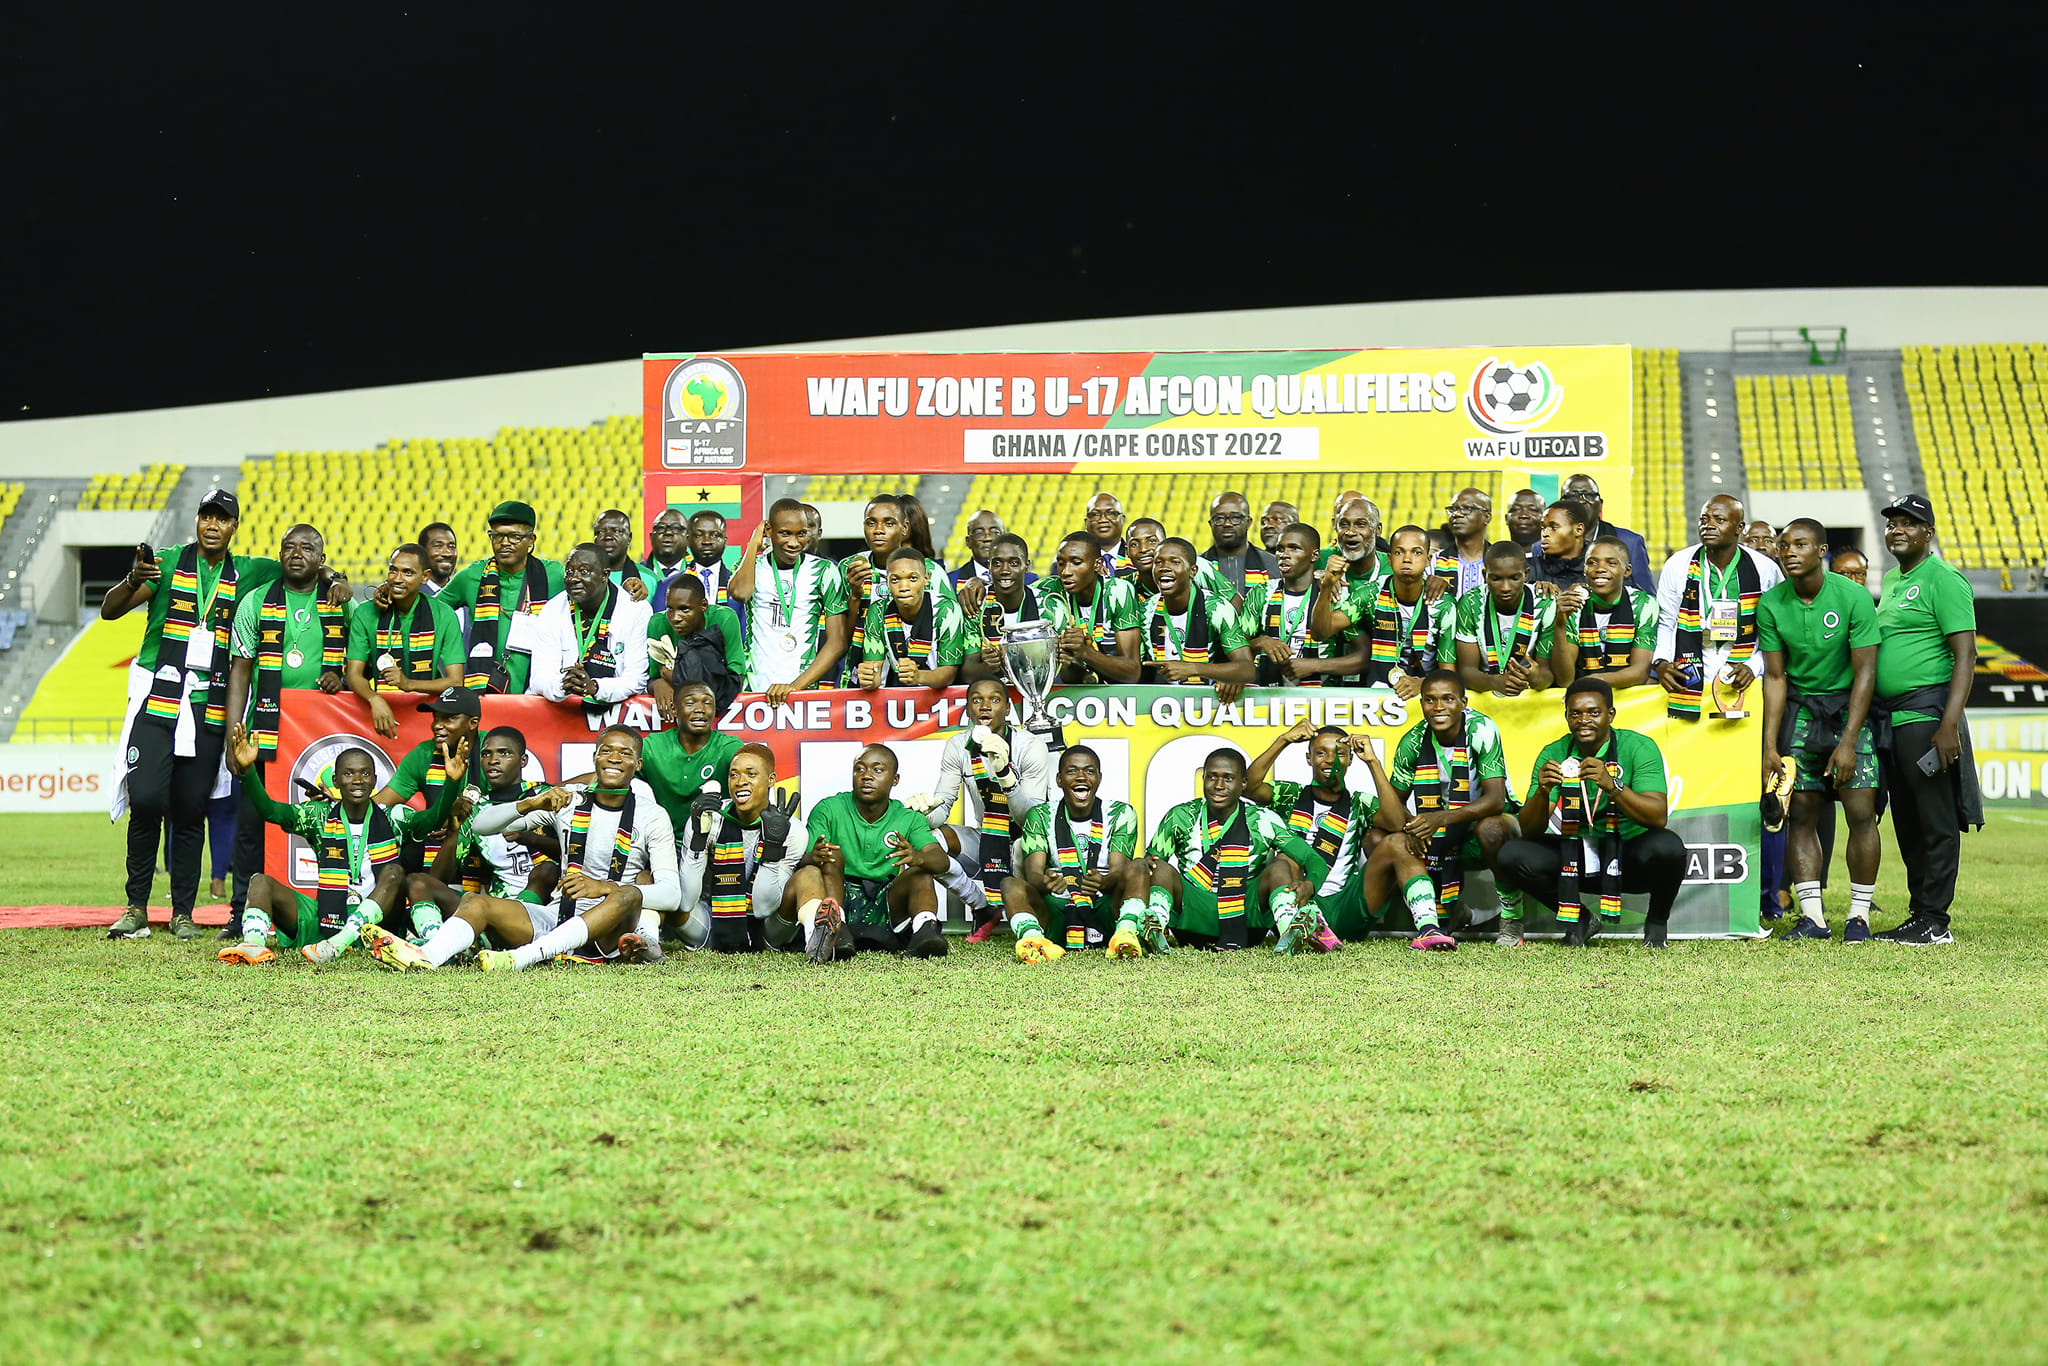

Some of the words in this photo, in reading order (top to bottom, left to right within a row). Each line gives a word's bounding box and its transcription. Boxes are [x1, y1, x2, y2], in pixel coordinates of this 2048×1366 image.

[806, 376, 910, 417] WAFU
[915, 376, 1004, 417] ZONE
[1010, 376, 1037, 417] B
[1043, 375, 1119, 417] U-17
[1123, 374, 1243, 416] AFCON
[1251, 371, 1457, 418] QUALIFIERS
[680, 421, 728, 434] CAF
[992, 433, 1066, 458] GHANA
[1146, 432, 1219, 457] COAST
[1224, 431, 1282, 456] 2022
[1467, 441, 1521, 457] WAFU
[1528, 438, 1577, 456] UFOA
[1583, 435, 1605, 457] B
[583, 703, 679, 732] WAF
[717, 700, 832, 731] ZONE
[845, 699, 873, 730] B
[1150, 695, 1409, 729] QUALIFIERS
[506, 851, 531, 876] 12
[1713, 848, 1745, 880] B
